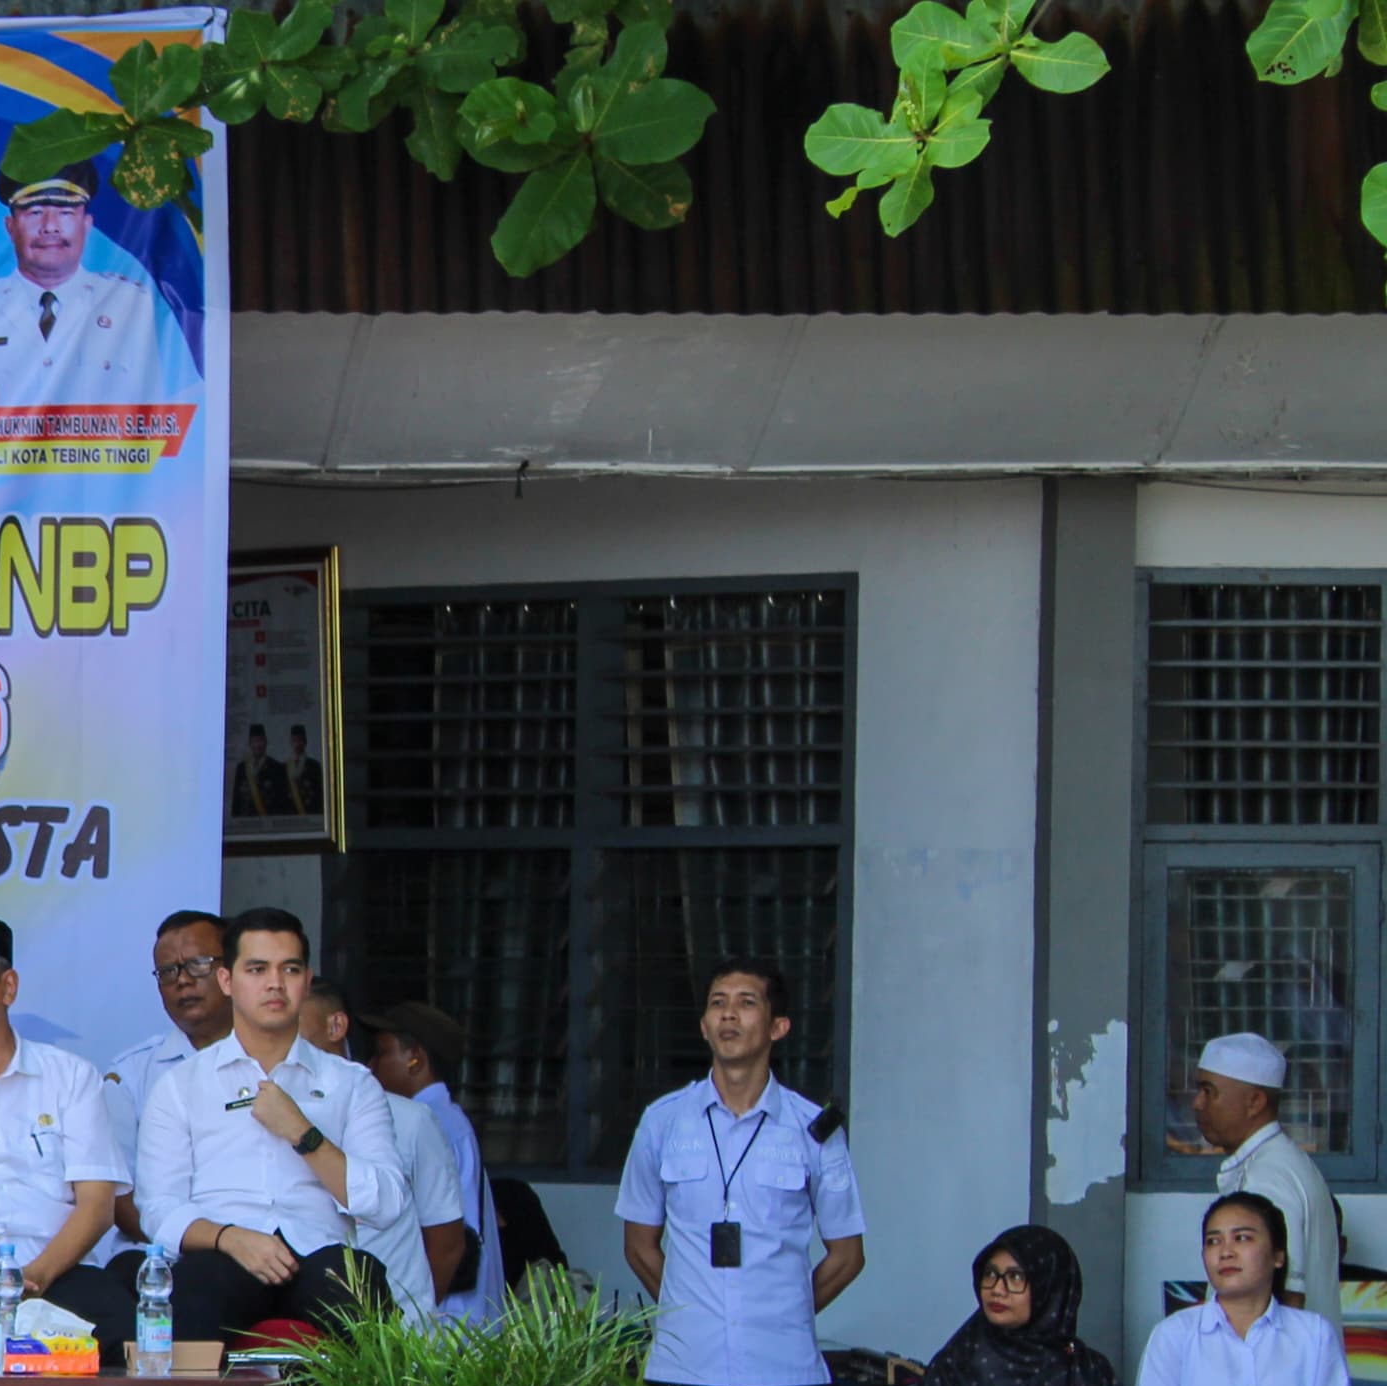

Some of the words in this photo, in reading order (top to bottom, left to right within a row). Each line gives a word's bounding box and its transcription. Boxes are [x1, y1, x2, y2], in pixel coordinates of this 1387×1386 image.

[12, 448, 47, 464] KOTA
[51, 447, 101, 464] TEBING
[105, 447, 150, 464] TINGGI
[232, 601, 271, 618] CITA
